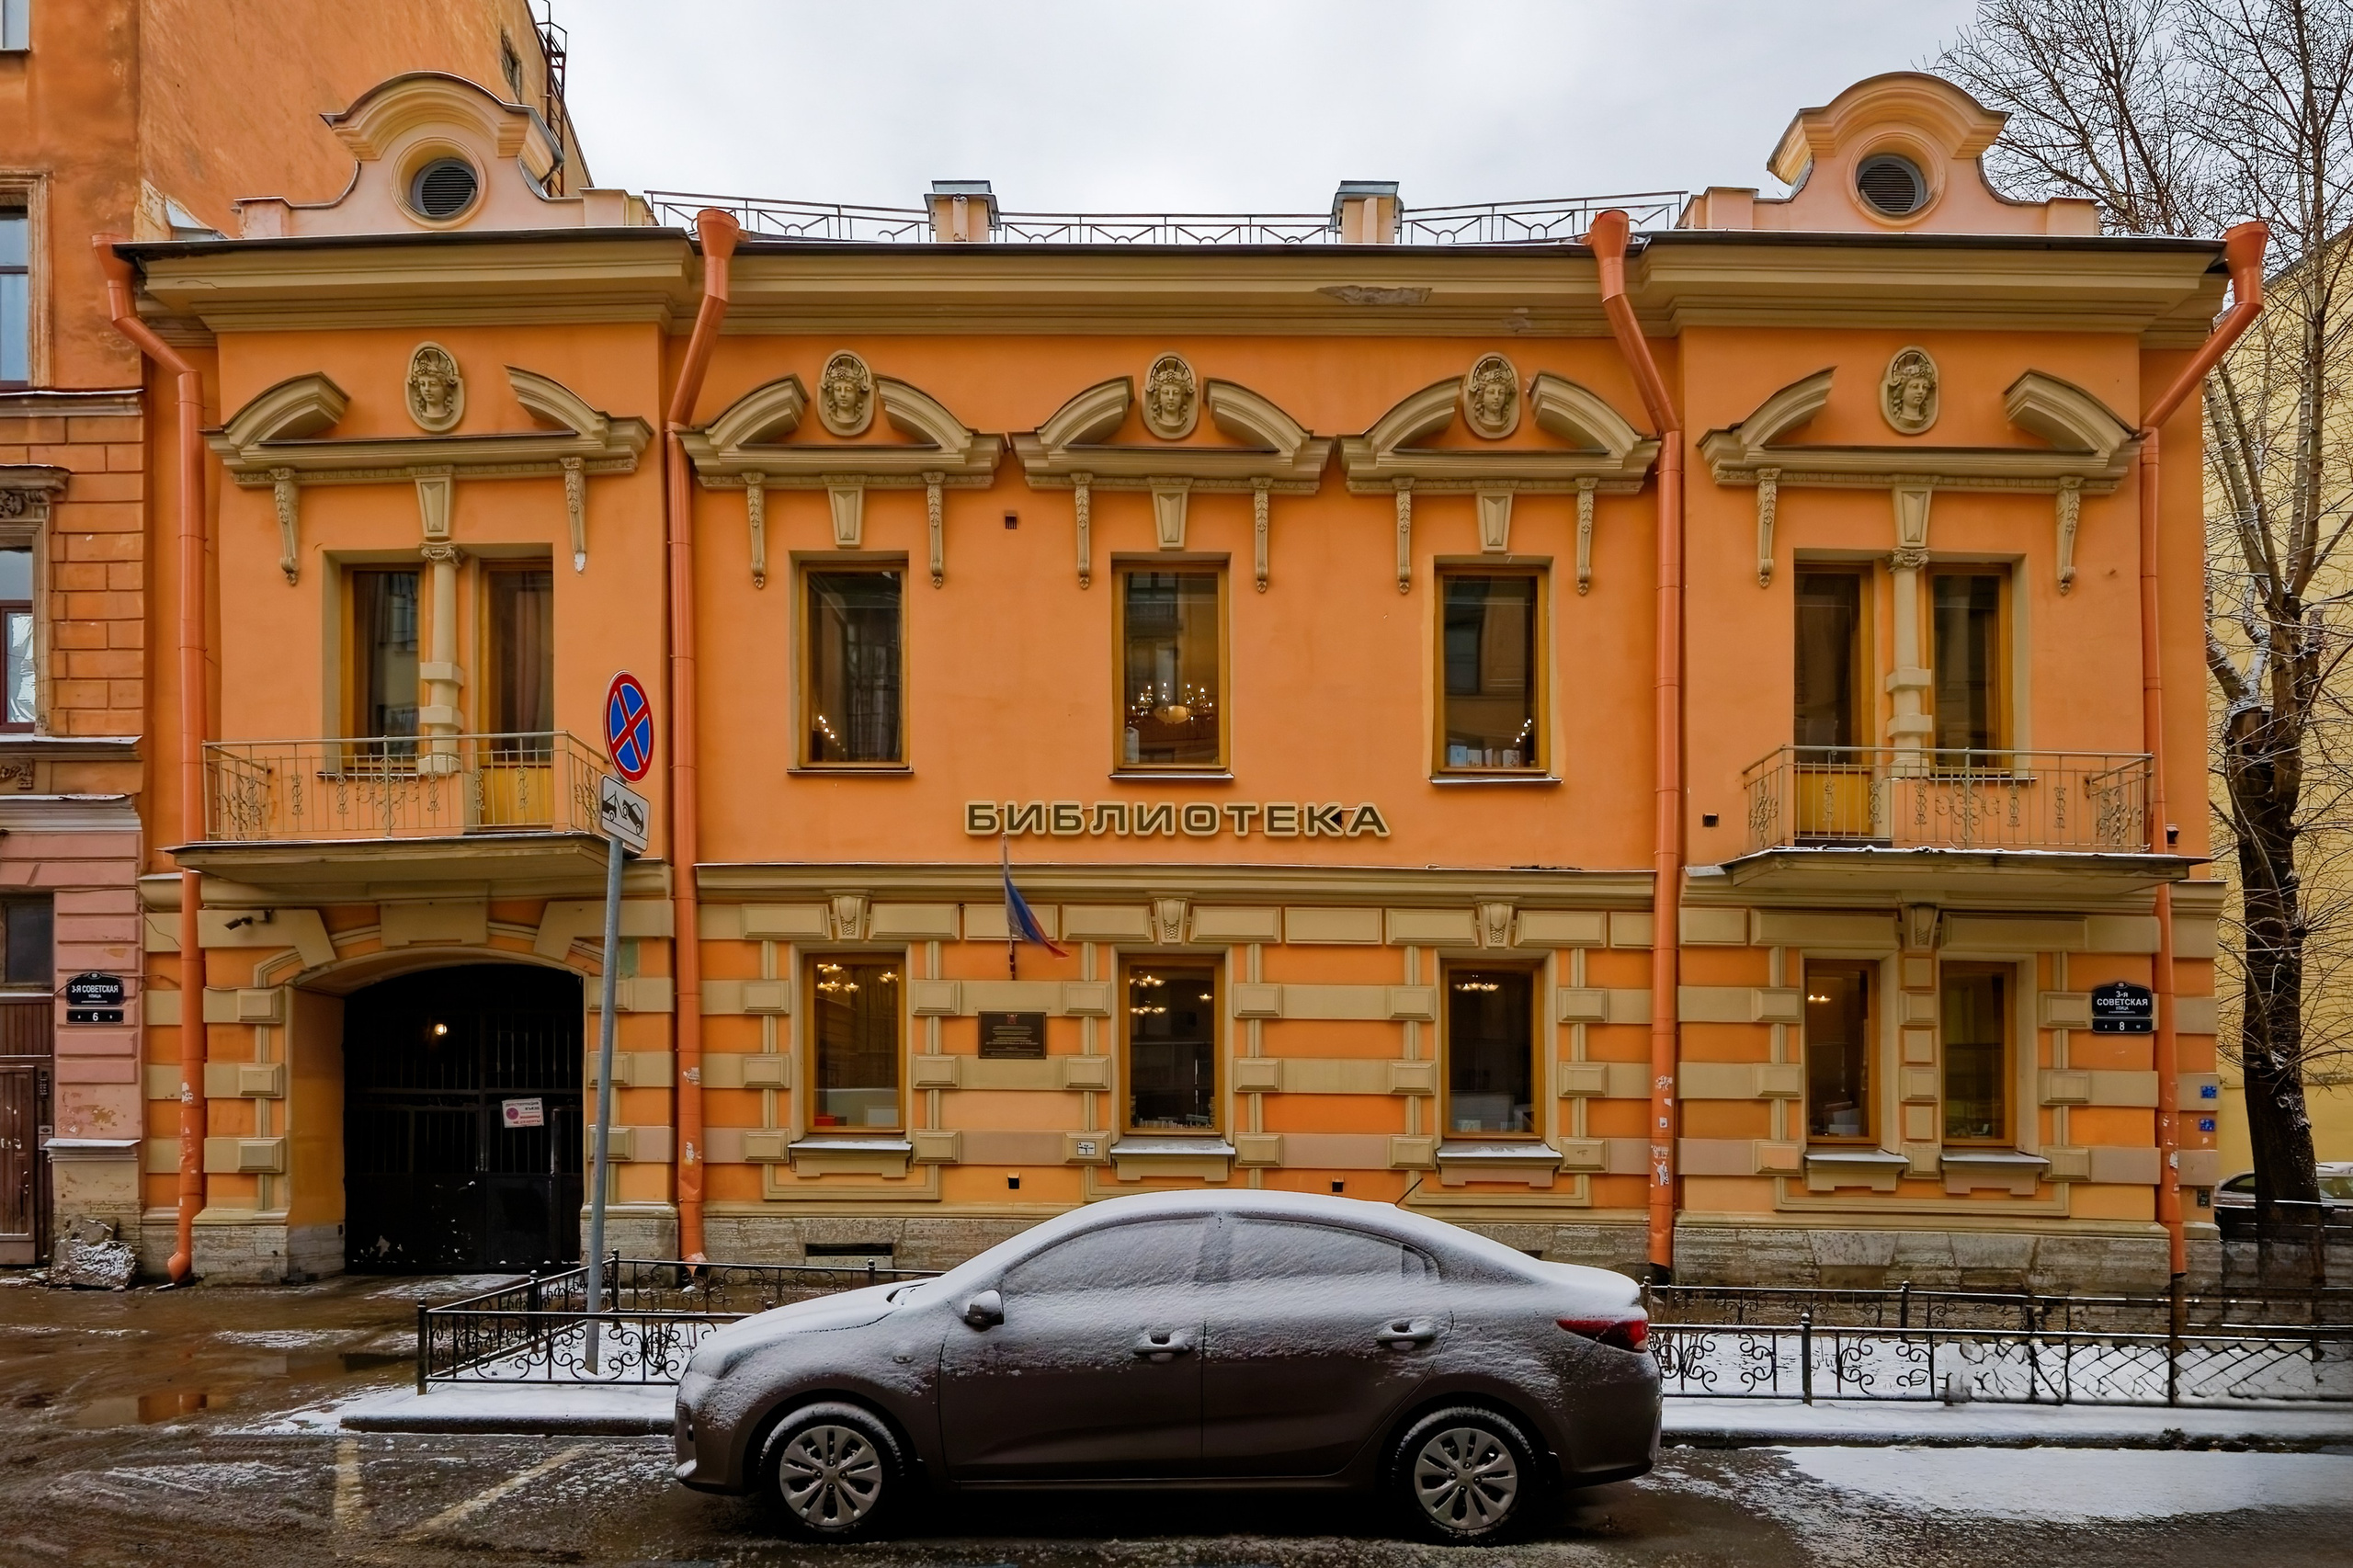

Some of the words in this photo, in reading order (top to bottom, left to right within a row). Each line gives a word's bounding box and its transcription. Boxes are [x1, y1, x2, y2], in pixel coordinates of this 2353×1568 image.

[966, 801, 1390, 835] БИБЛИОТЕКА
[93, 1012, 98, 1021] 6
[2119, 1021, 2125, 1030] 8
